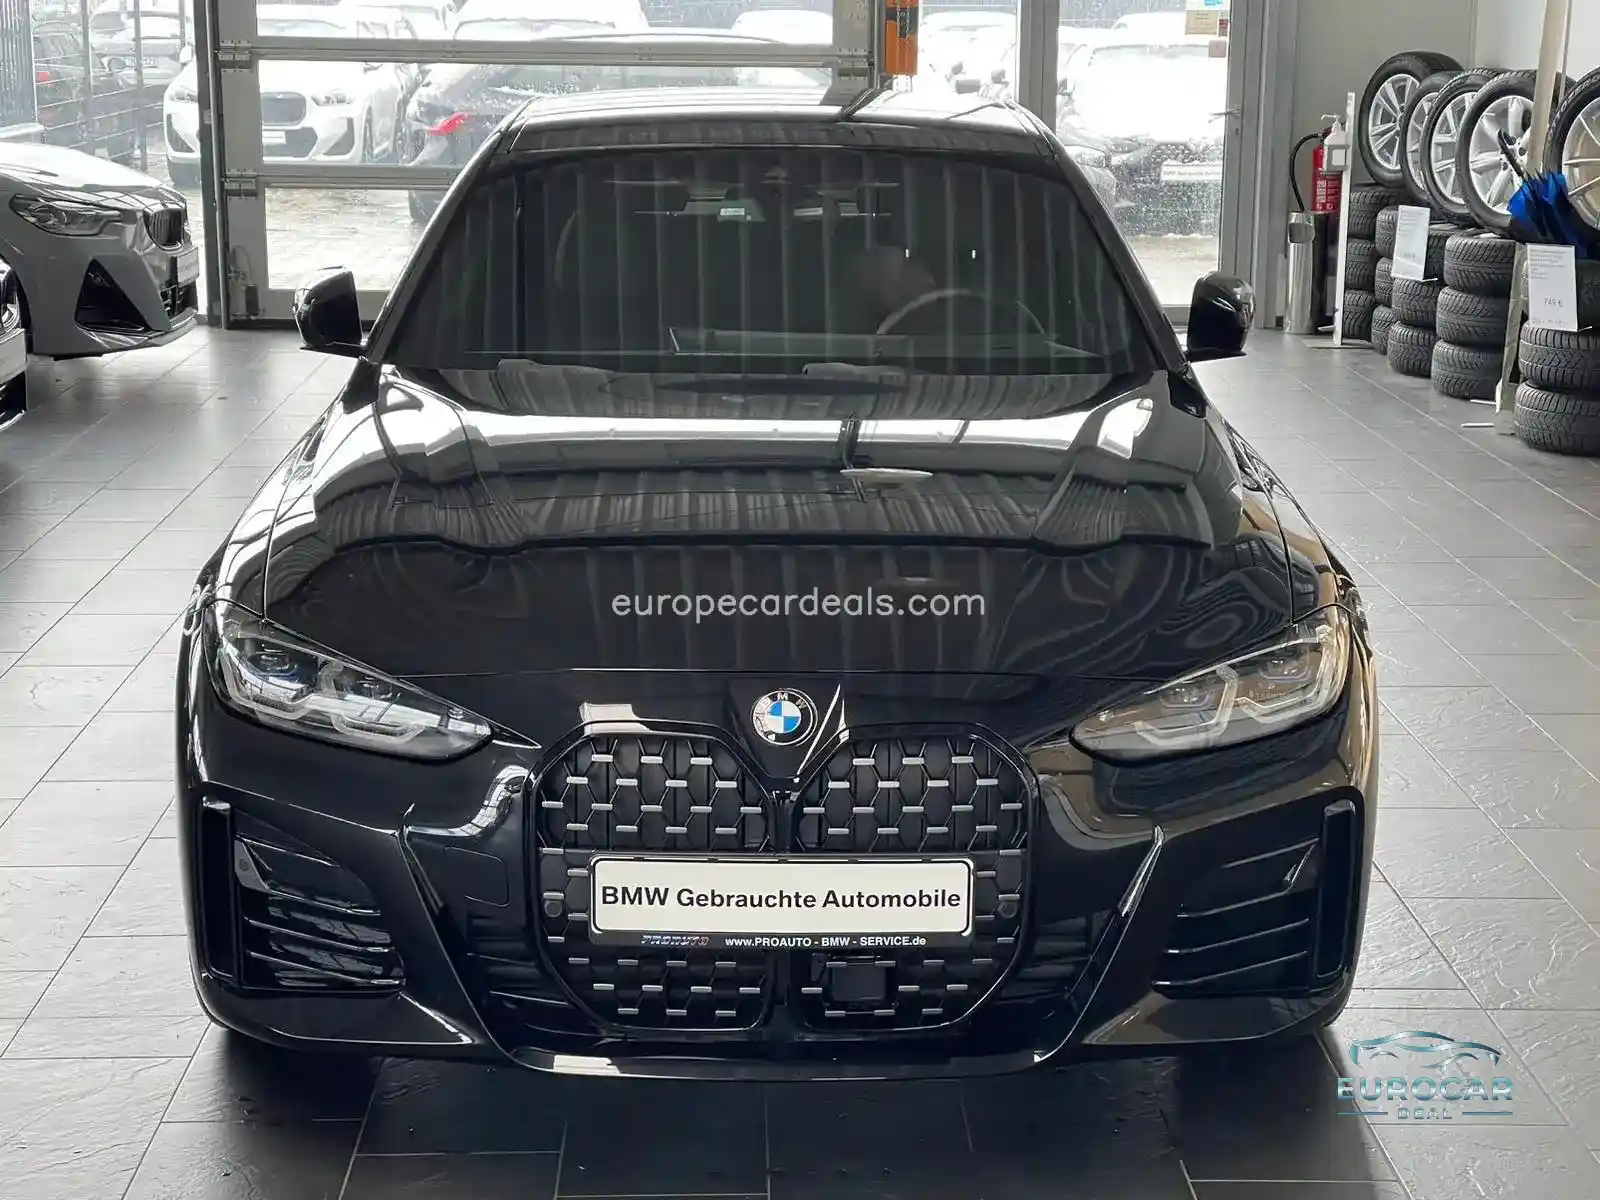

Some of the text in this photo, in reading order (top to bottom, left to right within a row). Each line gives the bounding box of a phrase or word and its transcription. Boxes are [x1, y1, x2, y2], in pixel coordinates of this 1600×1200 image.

[602, 886, 961, 908] BMW Gebrauchte Automobile
[725, 937, 812, 947] www.PROAUTO
[822, 937, 850, 947] BMW
[860, 936, 927, 946] SERVICE.de
